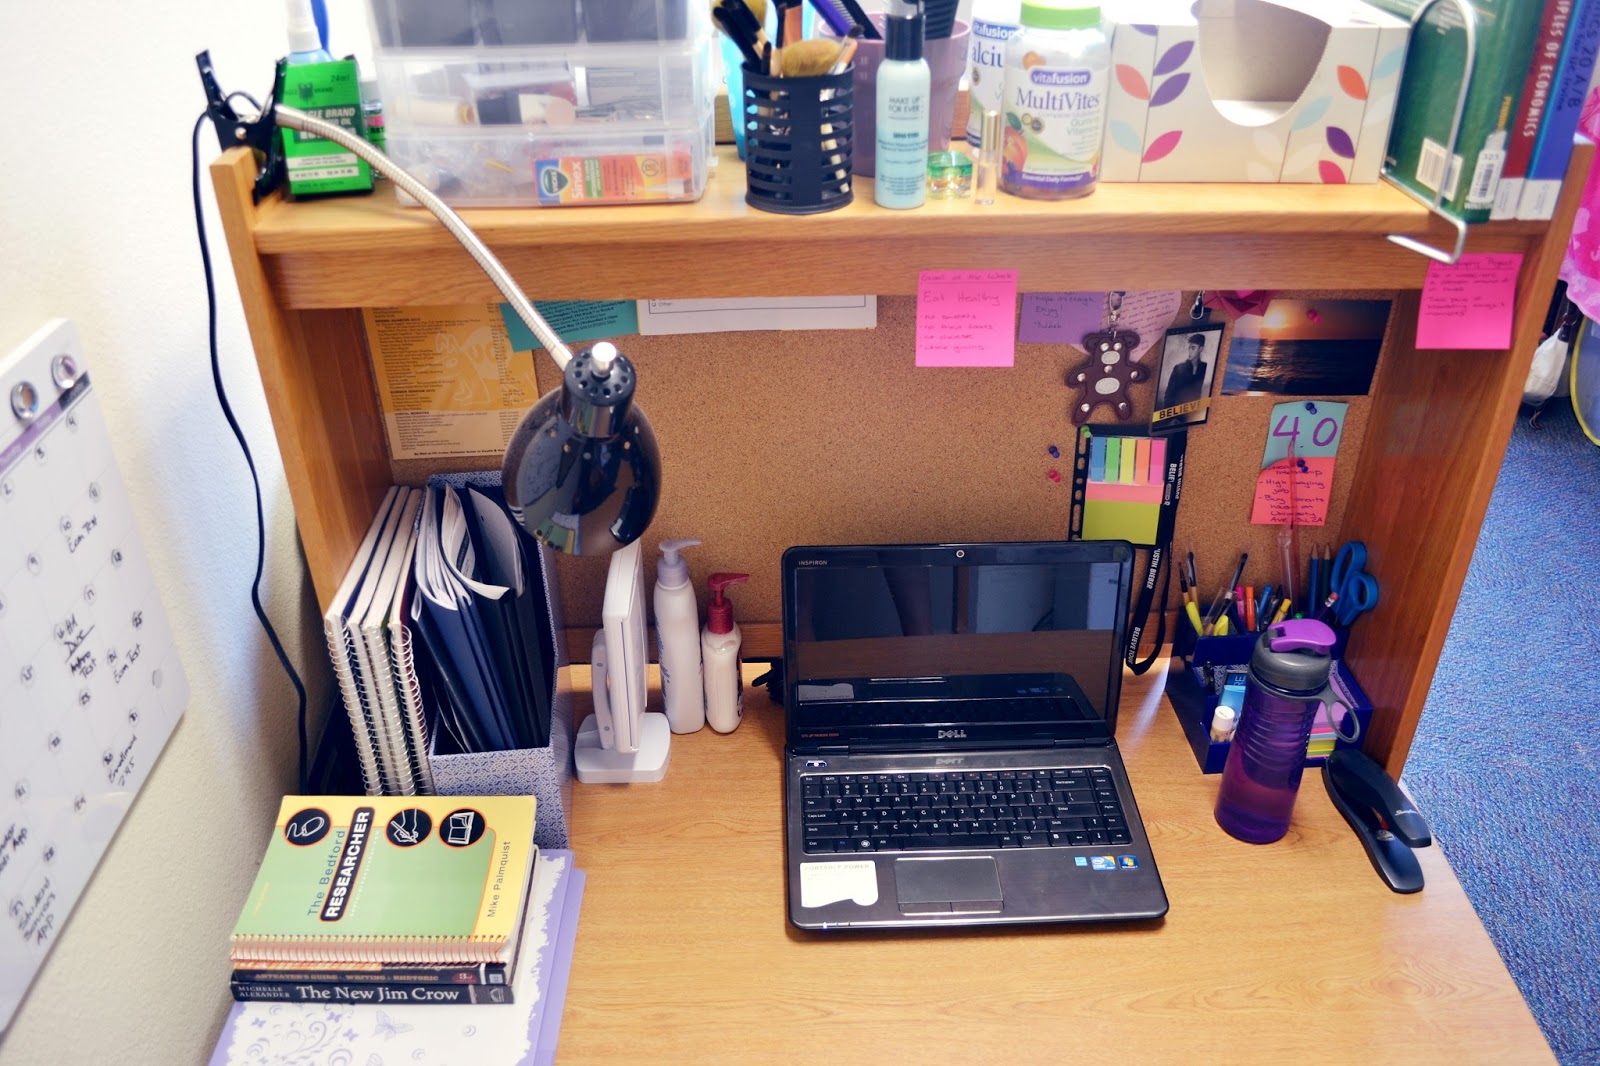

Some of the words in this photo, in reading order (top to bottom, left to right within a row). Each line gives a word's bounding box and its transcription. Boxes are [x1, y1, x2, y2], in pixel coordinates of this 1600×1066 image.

[1544, 42, 1560, 58] OF
[1033, 71, 1088, 84] vitafusion
[888, 96, 912, 104] MAKE
[888, 105, 903, 113] FOR
[904, 104, 920, 113] EVER
[1015, 87, 1100, 112] MultiVites
[1523, 64, 1553, 137] ECONOMICS
[325, 107, 355, 118] BRAND
[571, 161, 583, 200] Sinex
[923, 291, 945, 303] Eat
[957, 290, 1001, 306] Healthy
[1168, 462, 1178, 484] BELIE
[1265, 479, 1287, 488] High
[1152, 548, 1161, 574] USTIN
[1146, 571, 1157, 590] BIEBER
[1131, 626, 1141, 652] BELIEVE
[937, 729, 967, 739] DELL
[308, 891, 322, 916] The
[320, 830, 346, 886] Bedford
[325, 810, 369, 918] RESEARCHER
[493, 840, 511, 891] Palmquist
[487, 891, 501, 918] Mike
[311, 973, 338, 981] GUIDE
[296, 986, 331, 999] The
[335, 987, 374, 999] New
[378, 987, 408, 1001] Jim
[411, 988, 459, 1000] Crow
